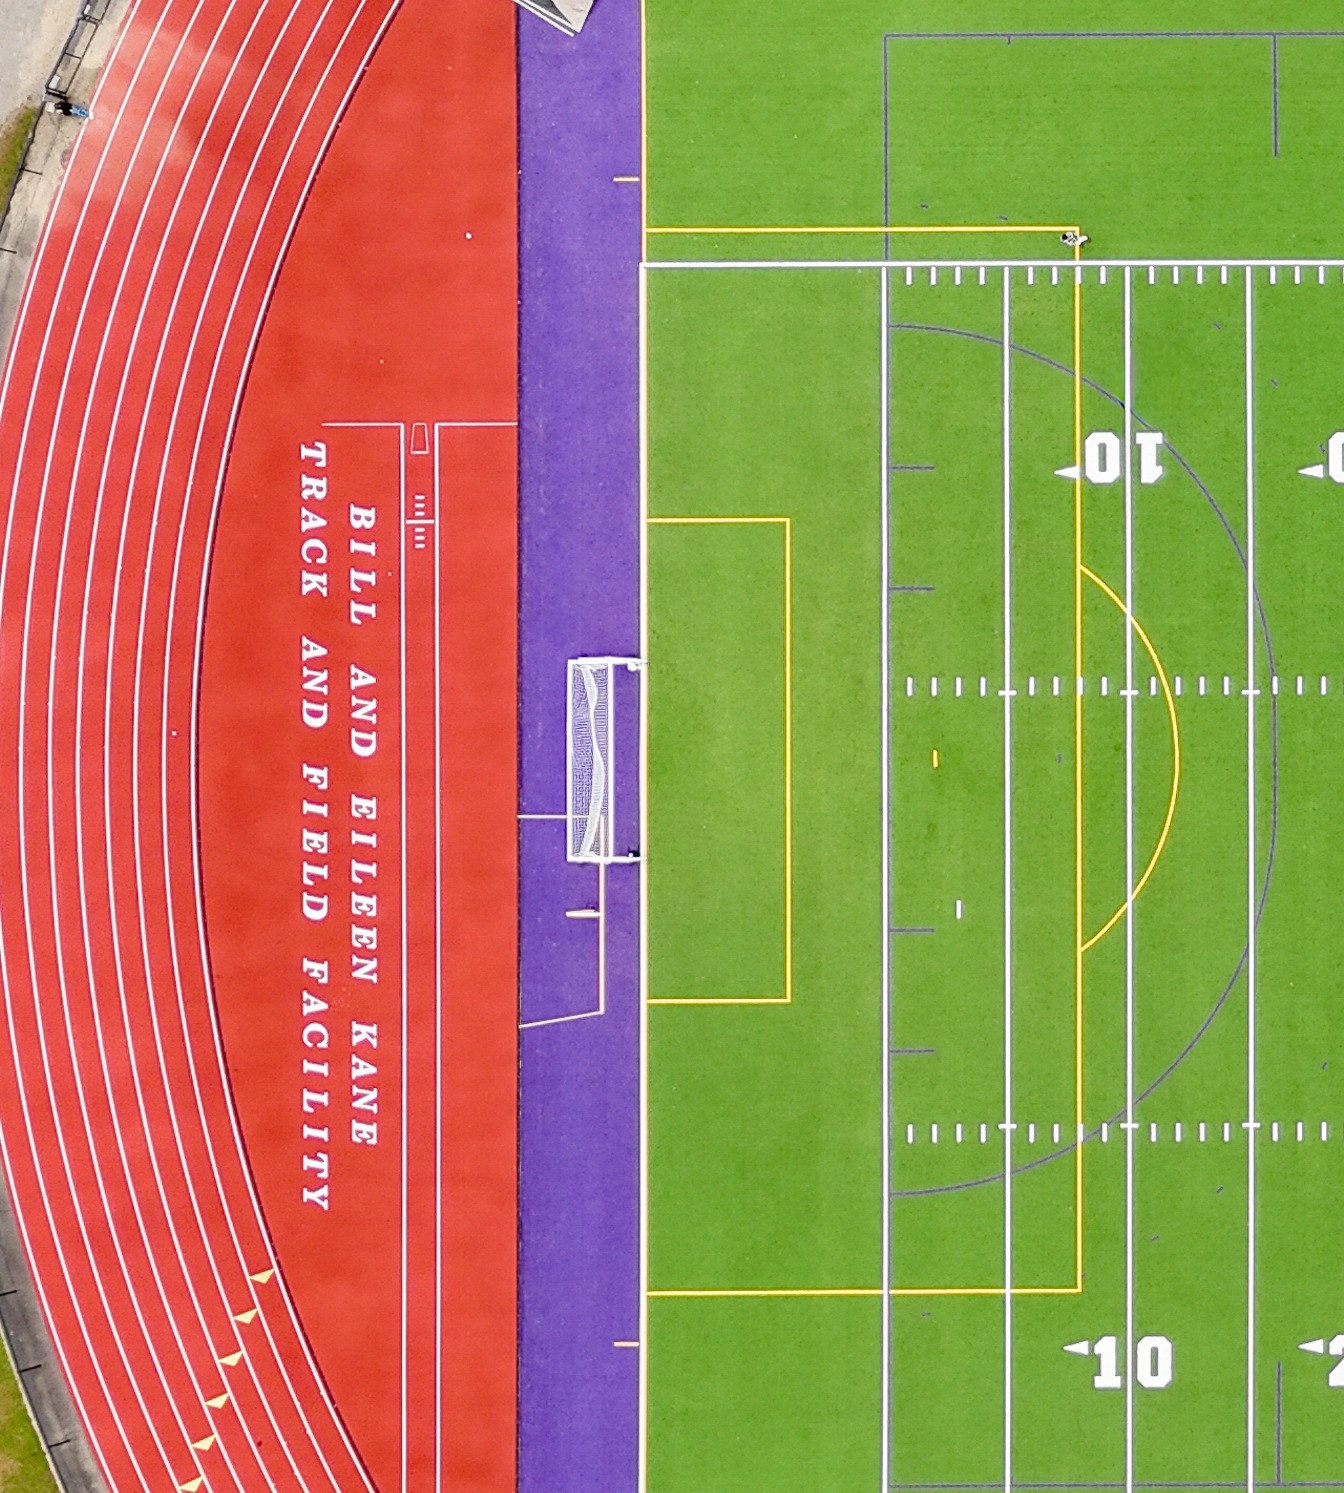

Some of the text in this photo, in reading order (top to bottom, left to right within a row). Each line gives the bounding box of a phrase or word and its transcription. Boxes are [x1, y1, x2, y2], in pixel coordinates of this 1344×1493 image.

[1085, 431, 1167, 484] 10
[301, 441, 329, 1211] TRACK AND FIELD FACILITY
[349, 503, 378, 1145] BILL AND EILEEN KANE
[1093, 1335, 1173, 1389] 10
